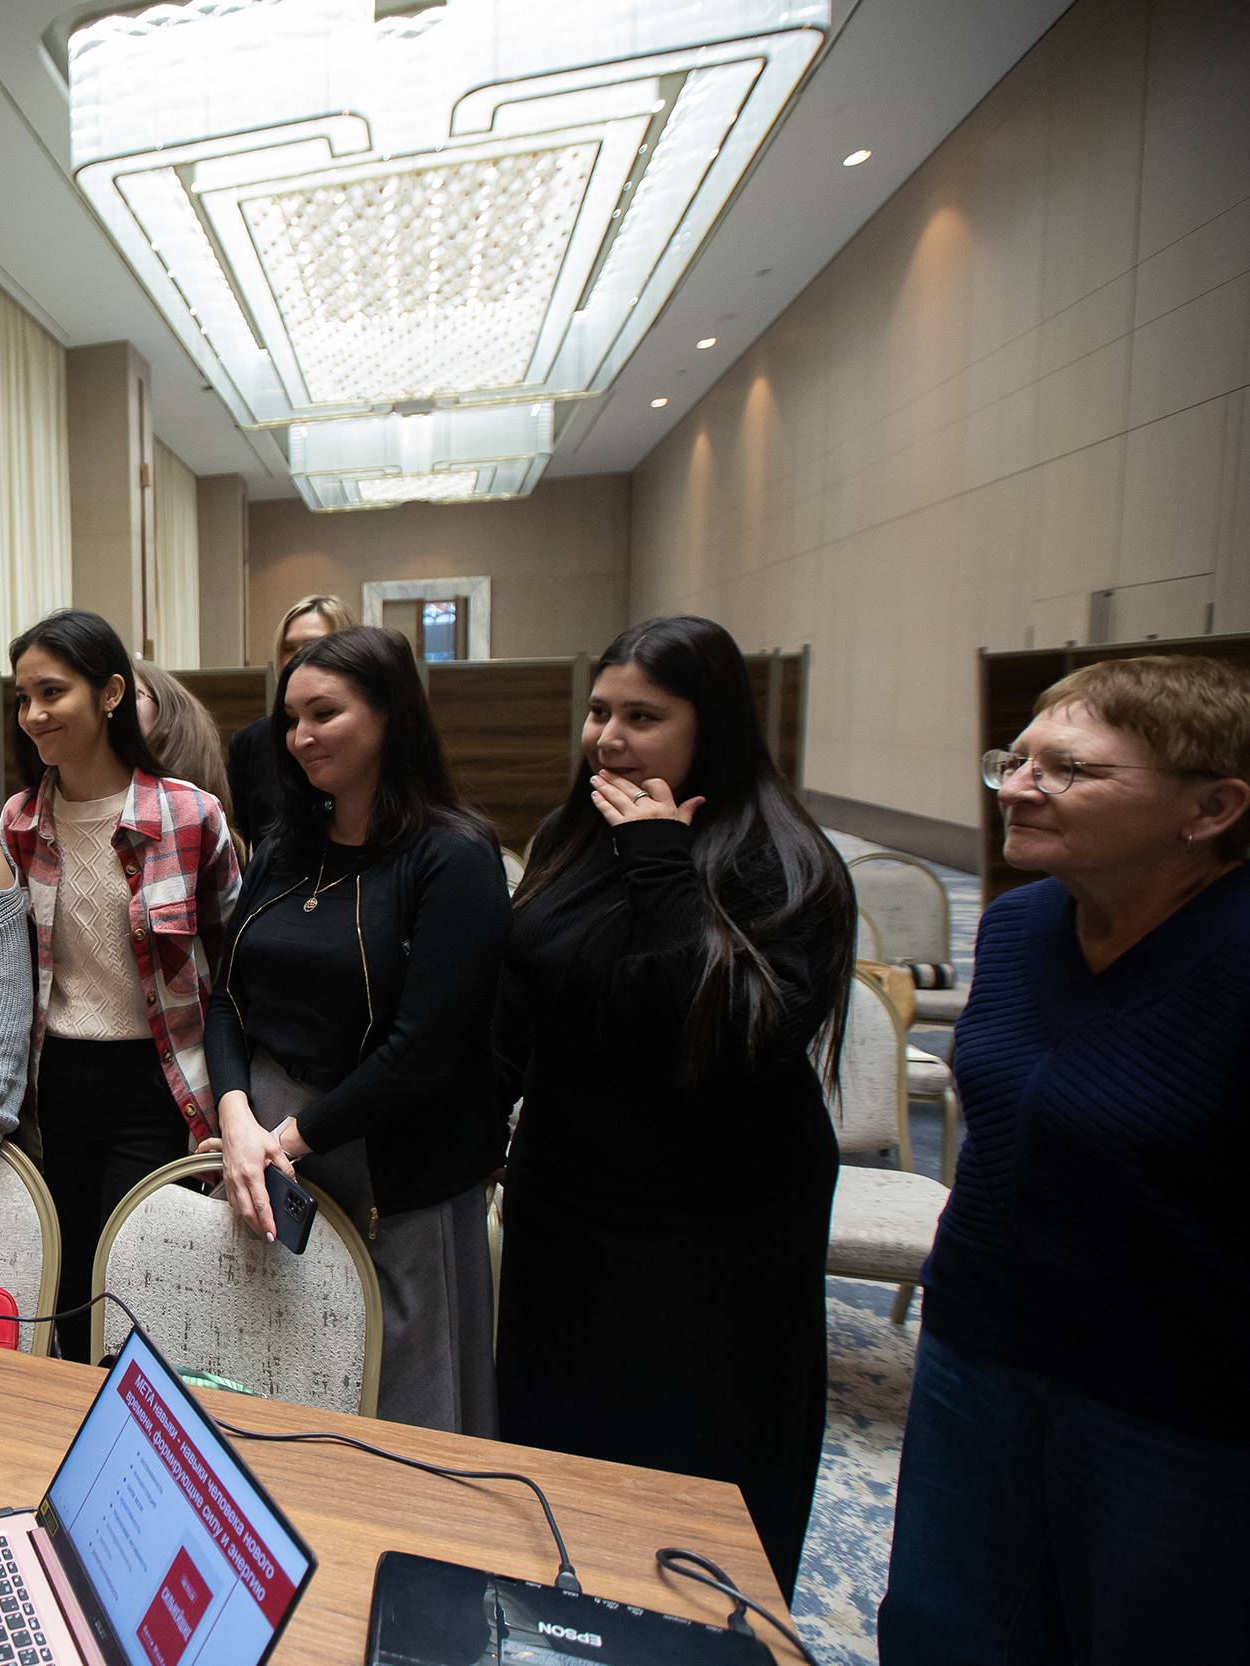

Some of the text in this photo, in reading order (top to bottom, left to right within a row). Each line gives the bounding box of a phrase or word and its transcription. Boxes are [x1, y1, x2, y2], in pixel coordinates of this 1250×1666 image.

[125, 1391, 266, 1601] времени, формирующие силу и энергию
[134, 1374, 155, 1407] МЕТА
[153, 1402, 178, 1440] навыки
[180, 1442, 208, 1484] навыки
[208, 1478, 245, 1536] человека
[242, 1531, 275, 1579] нового
[161, 1586, 193, 1642] СИЛЬНЕЙШИЕ
[538, 1621, 603, 1648] EPSON
